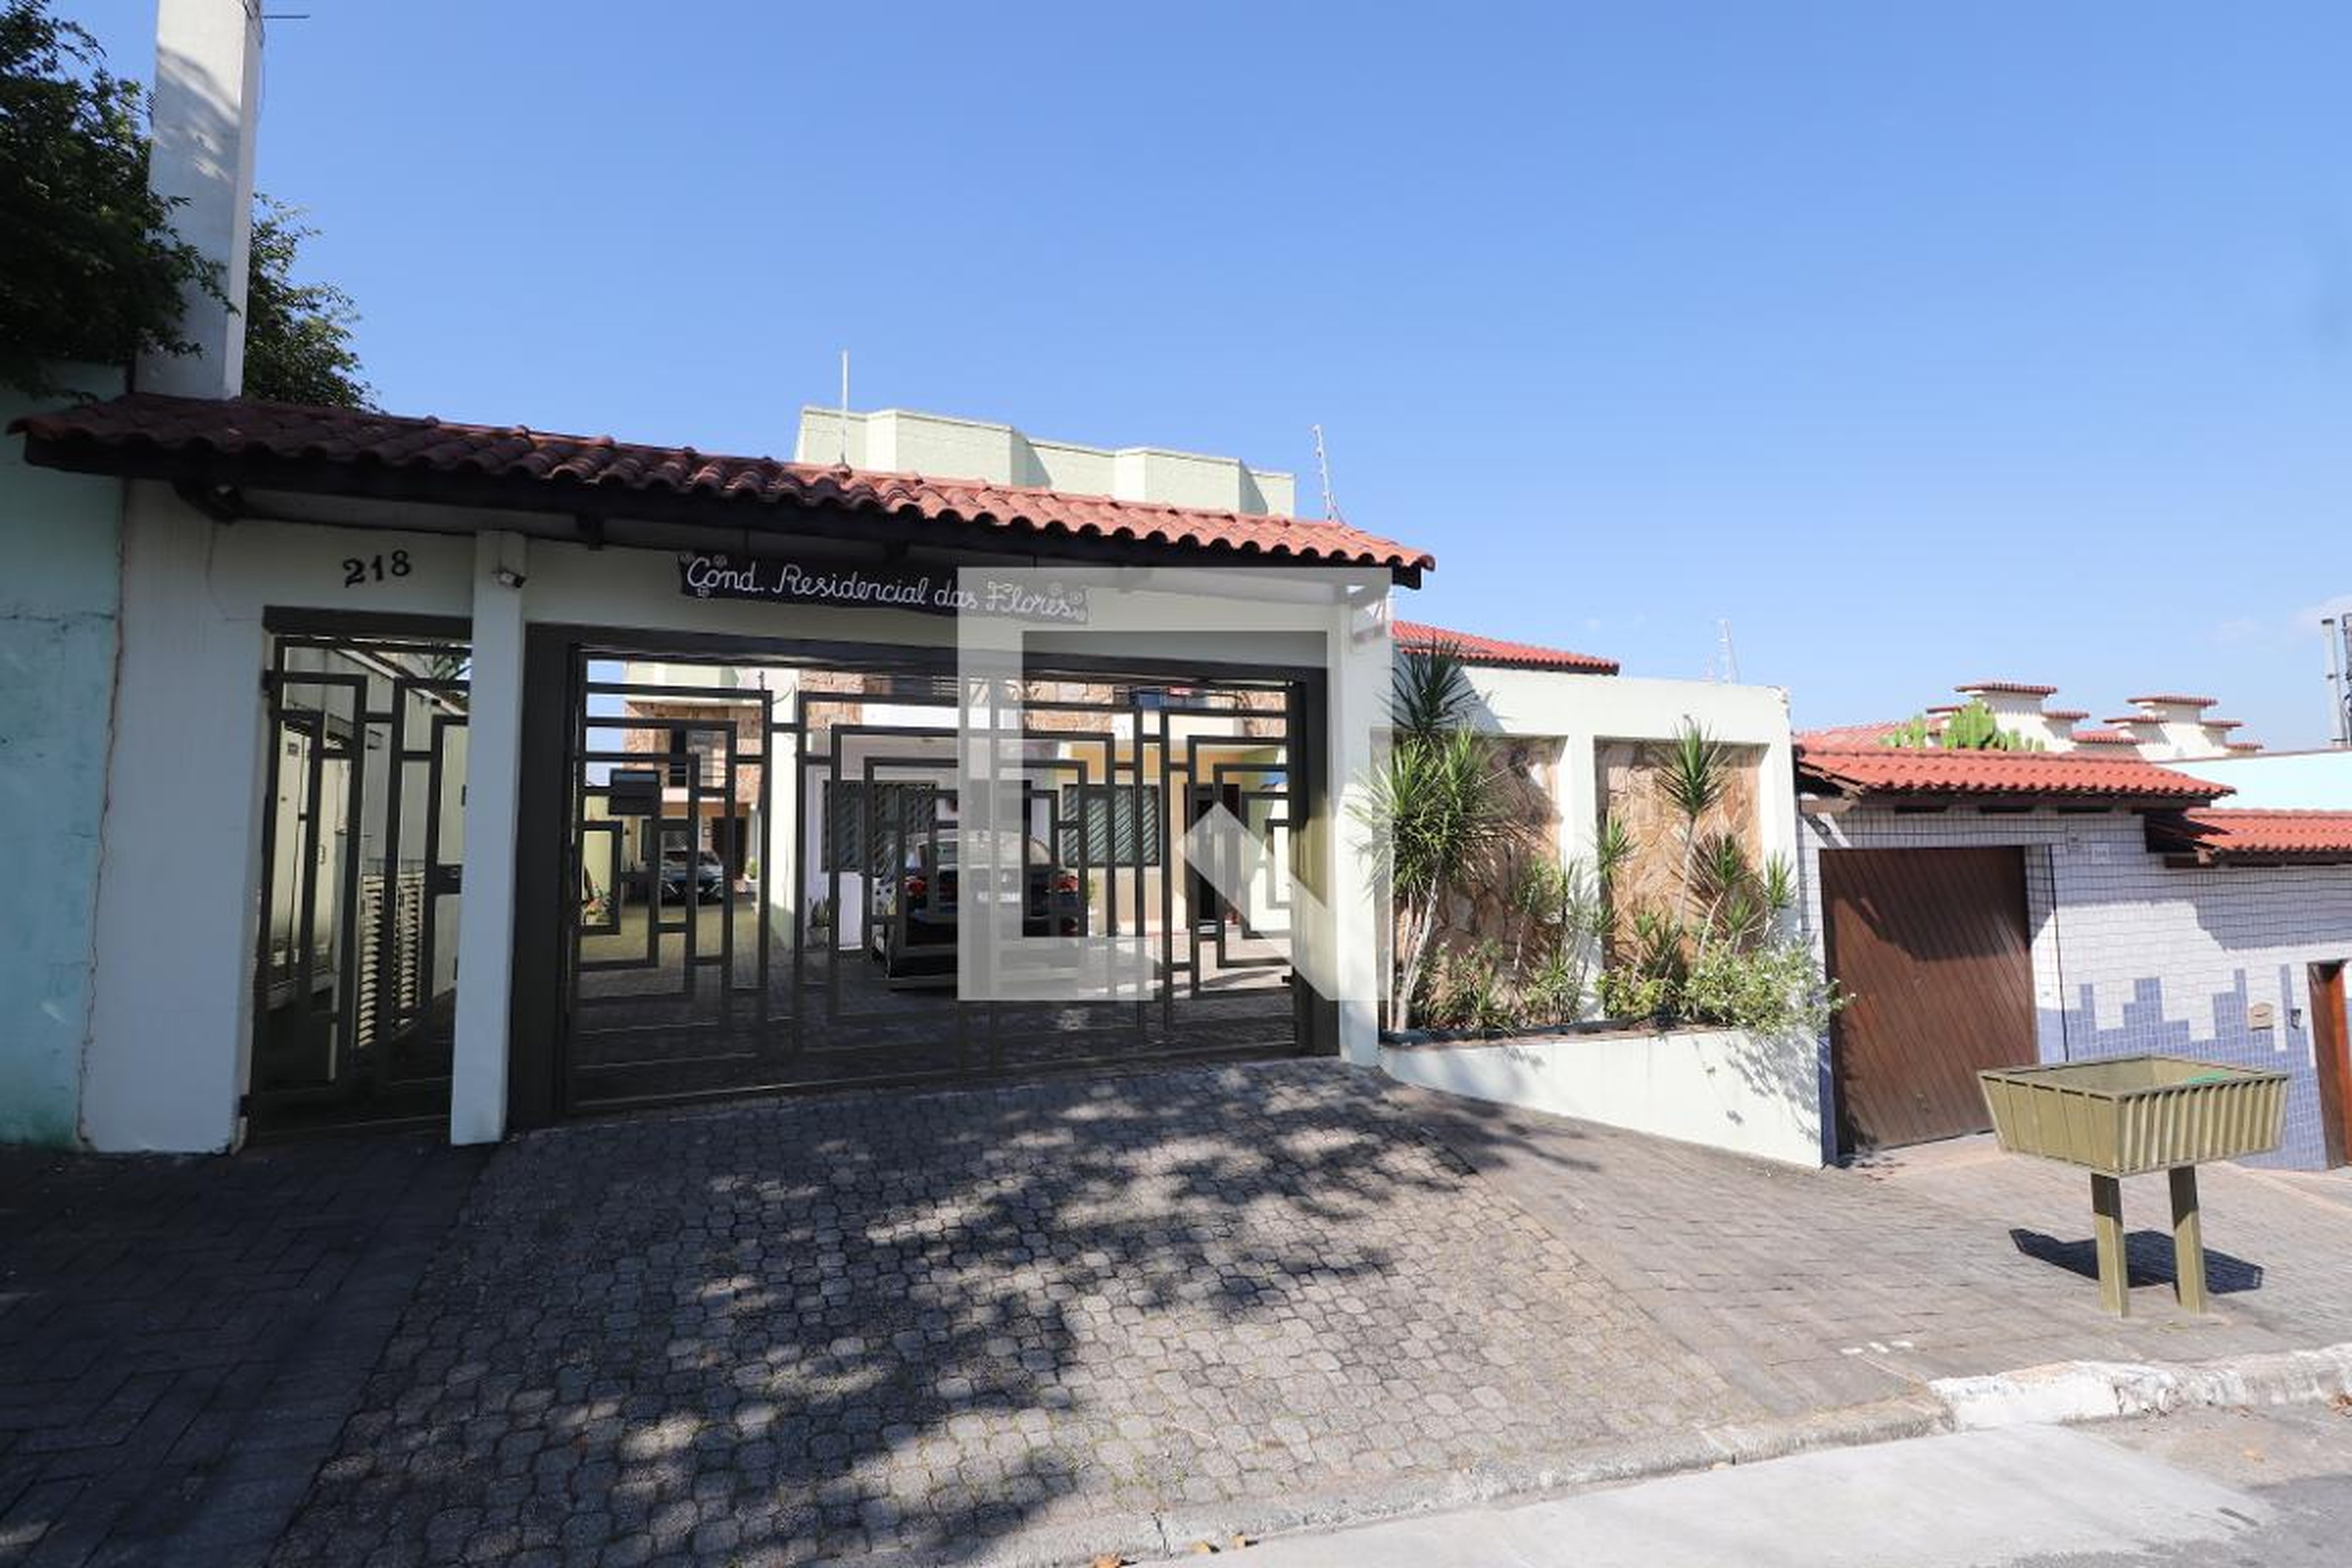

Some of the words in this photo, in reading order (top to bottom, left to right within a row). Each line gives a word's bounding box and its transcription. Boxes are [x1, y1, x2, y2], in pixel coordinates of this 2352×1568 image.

[342, 549, 411, 588] 218
[771, 564, 929, 605] Residencial
[933, 578, 978, 609] das
[986, 581, 1078, 618] Flores
